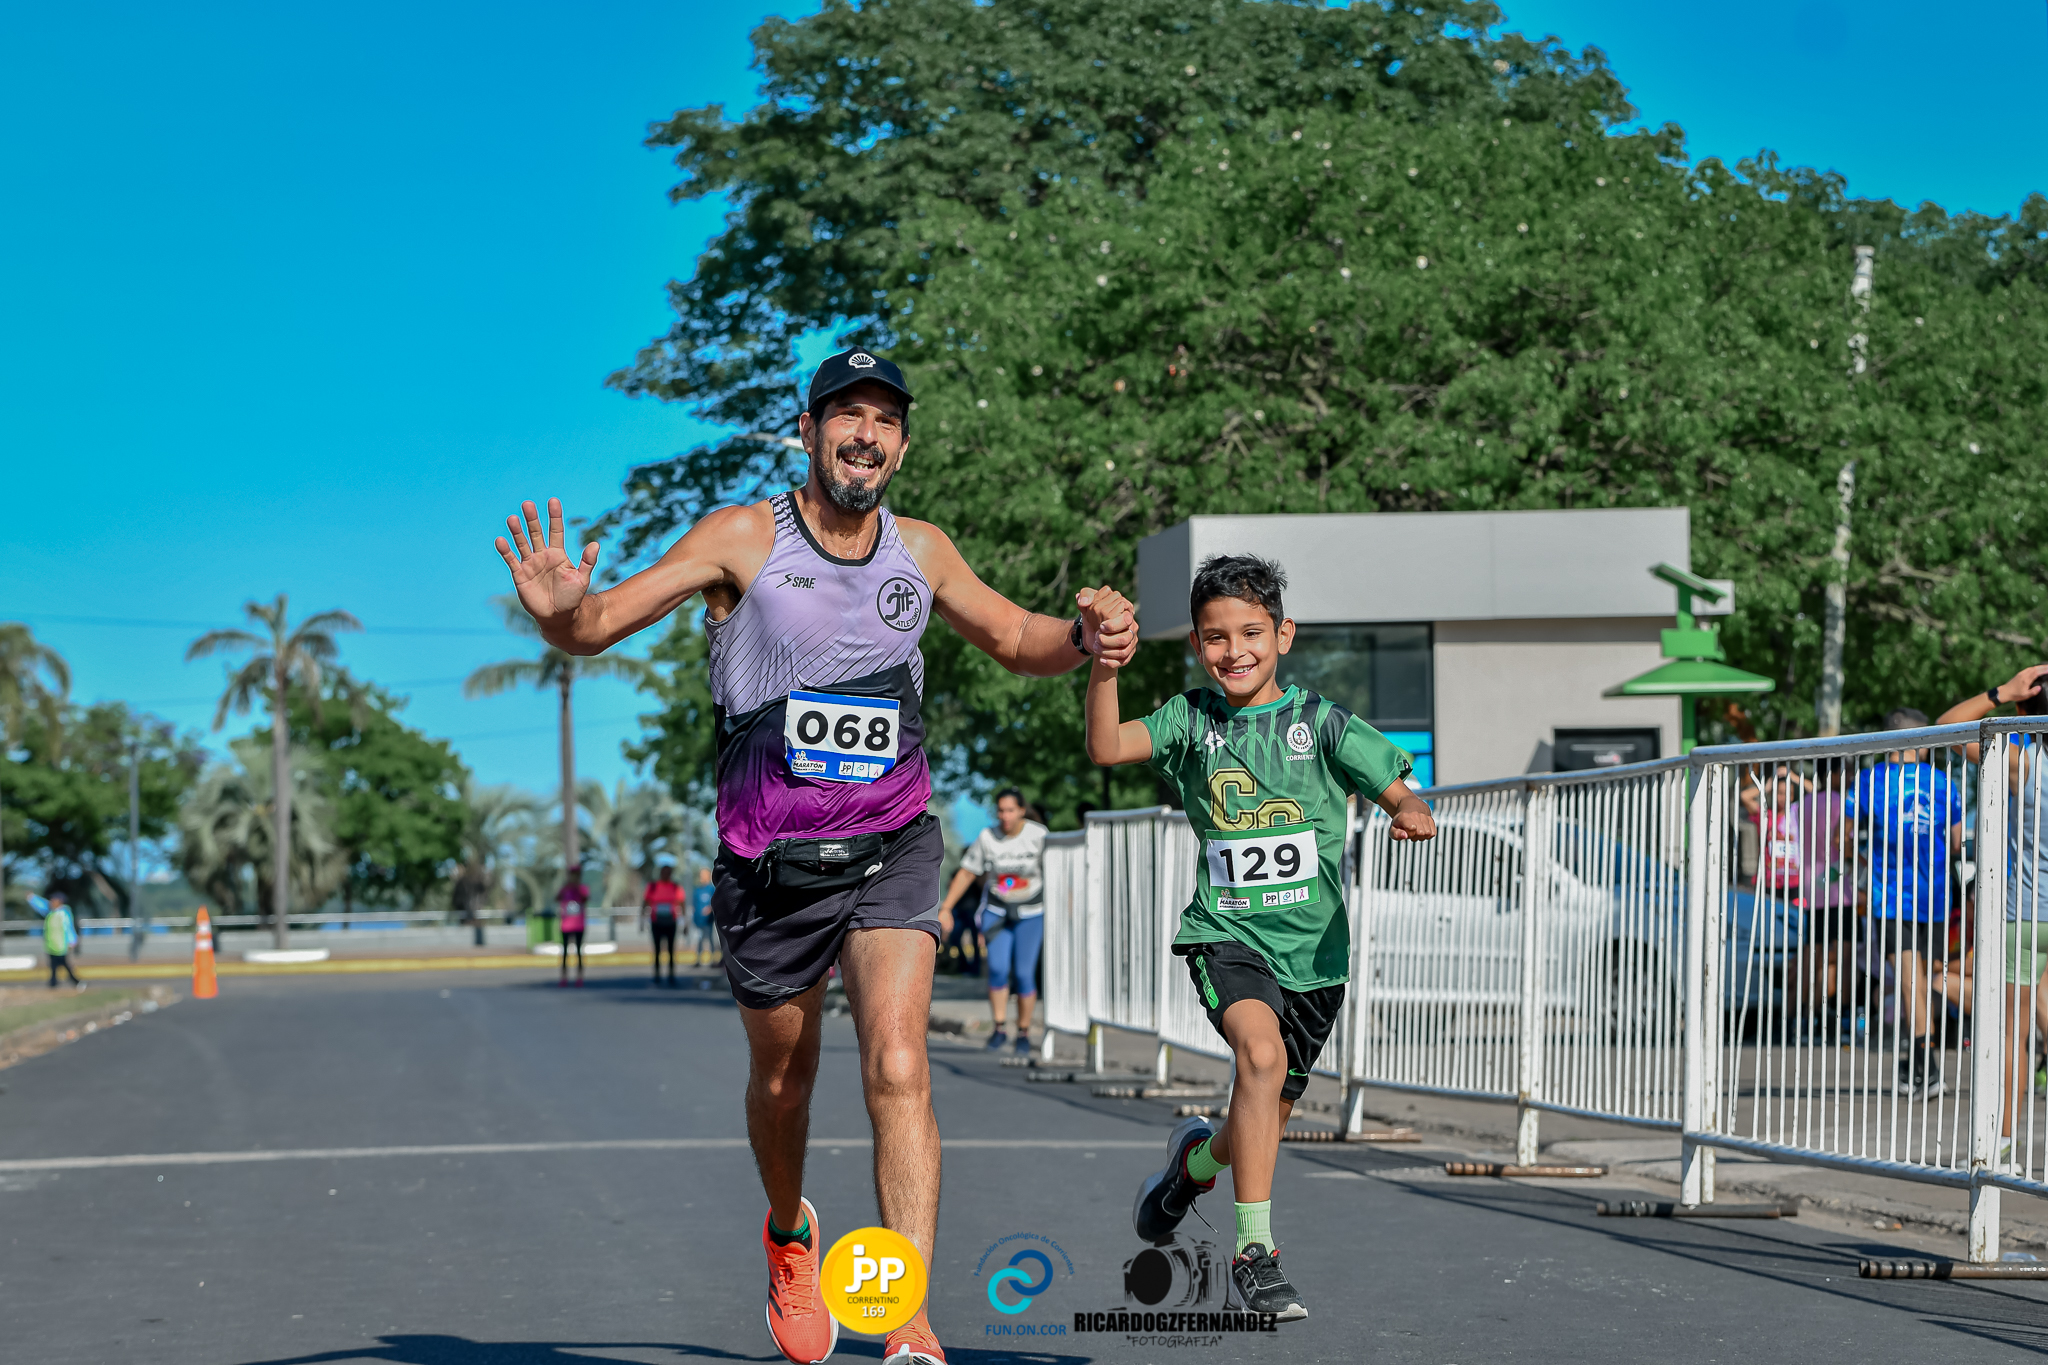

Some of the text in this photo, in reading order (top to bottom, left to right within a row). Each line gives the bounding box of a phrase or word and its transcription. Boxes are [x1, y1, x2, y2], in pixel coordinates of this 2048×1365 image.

[895, 607, 919, 628] ATLETISMO
[796, 710, 891, 751] 068
[793, 760, 824, 769] MARATÓN
[1218, 843, 1301, 883] 129
